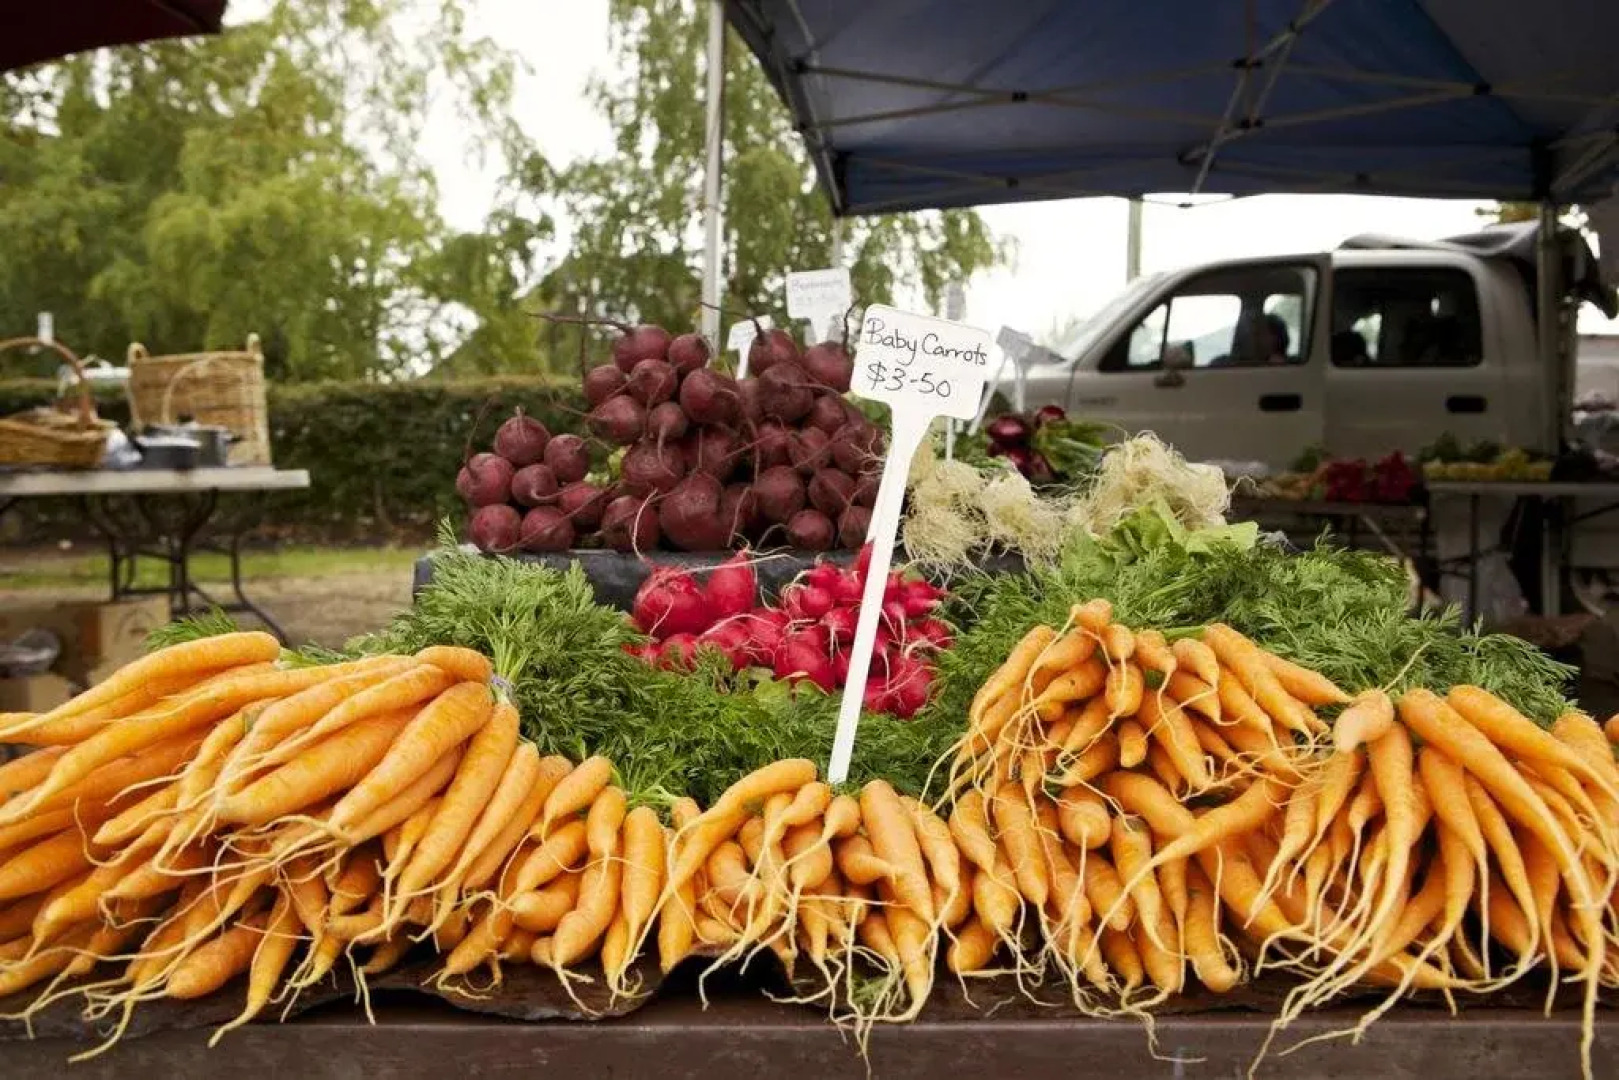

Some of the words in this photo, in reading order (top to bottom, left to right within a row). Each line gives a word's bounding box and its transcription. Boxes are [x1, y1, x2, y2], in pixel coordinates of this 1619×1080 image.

[865, 318, 917, 366] Baby
[922, 333, 987, 366] Carrots
[867, 362, 951, 397] $3-50
